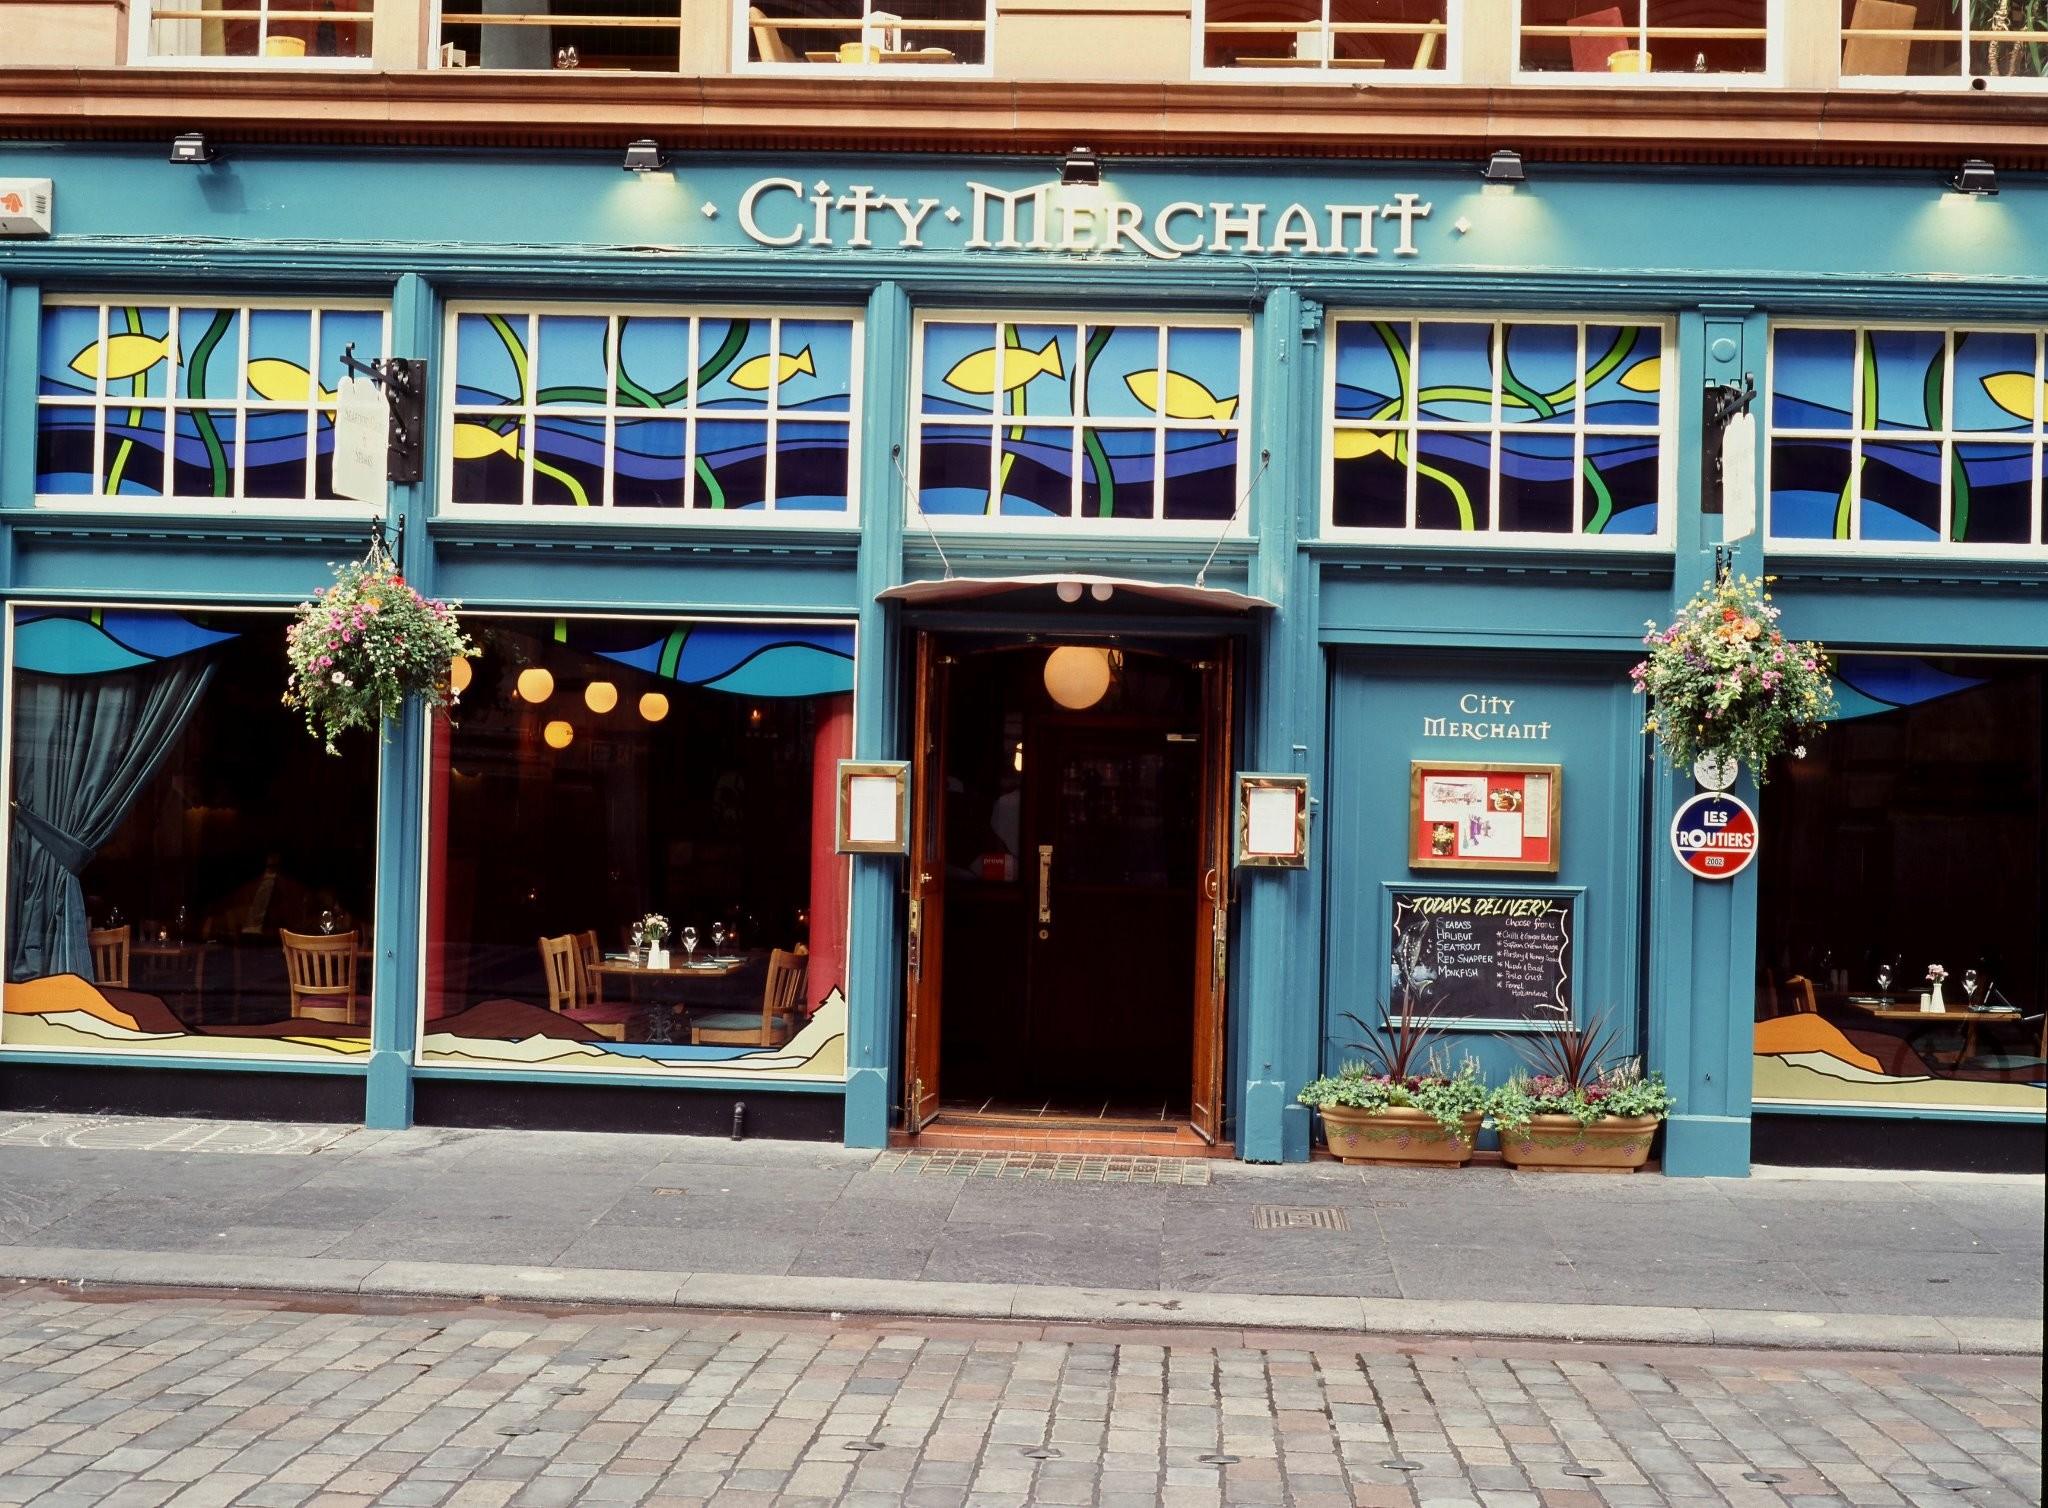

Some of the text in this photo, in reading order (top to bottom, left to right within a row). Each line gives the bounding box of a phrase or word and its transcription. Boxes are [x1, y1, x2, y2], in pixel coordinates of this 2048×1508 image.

[1703, 811, 1728, 827] LES
[1680, 829, 1752, 848] ROUTIERS
[1706, 857, 1724, 866] 2002
[1412, 897, 1553, 918] TODAYS DELIVERY
[1505, 918, 1532, 927] Choose
[1436, 928, 1473, 941] HALIBUT
[1437, 951, 1494, 964] RED SNAPPER
[1438, 965, 1479, 978] MONKFISH
